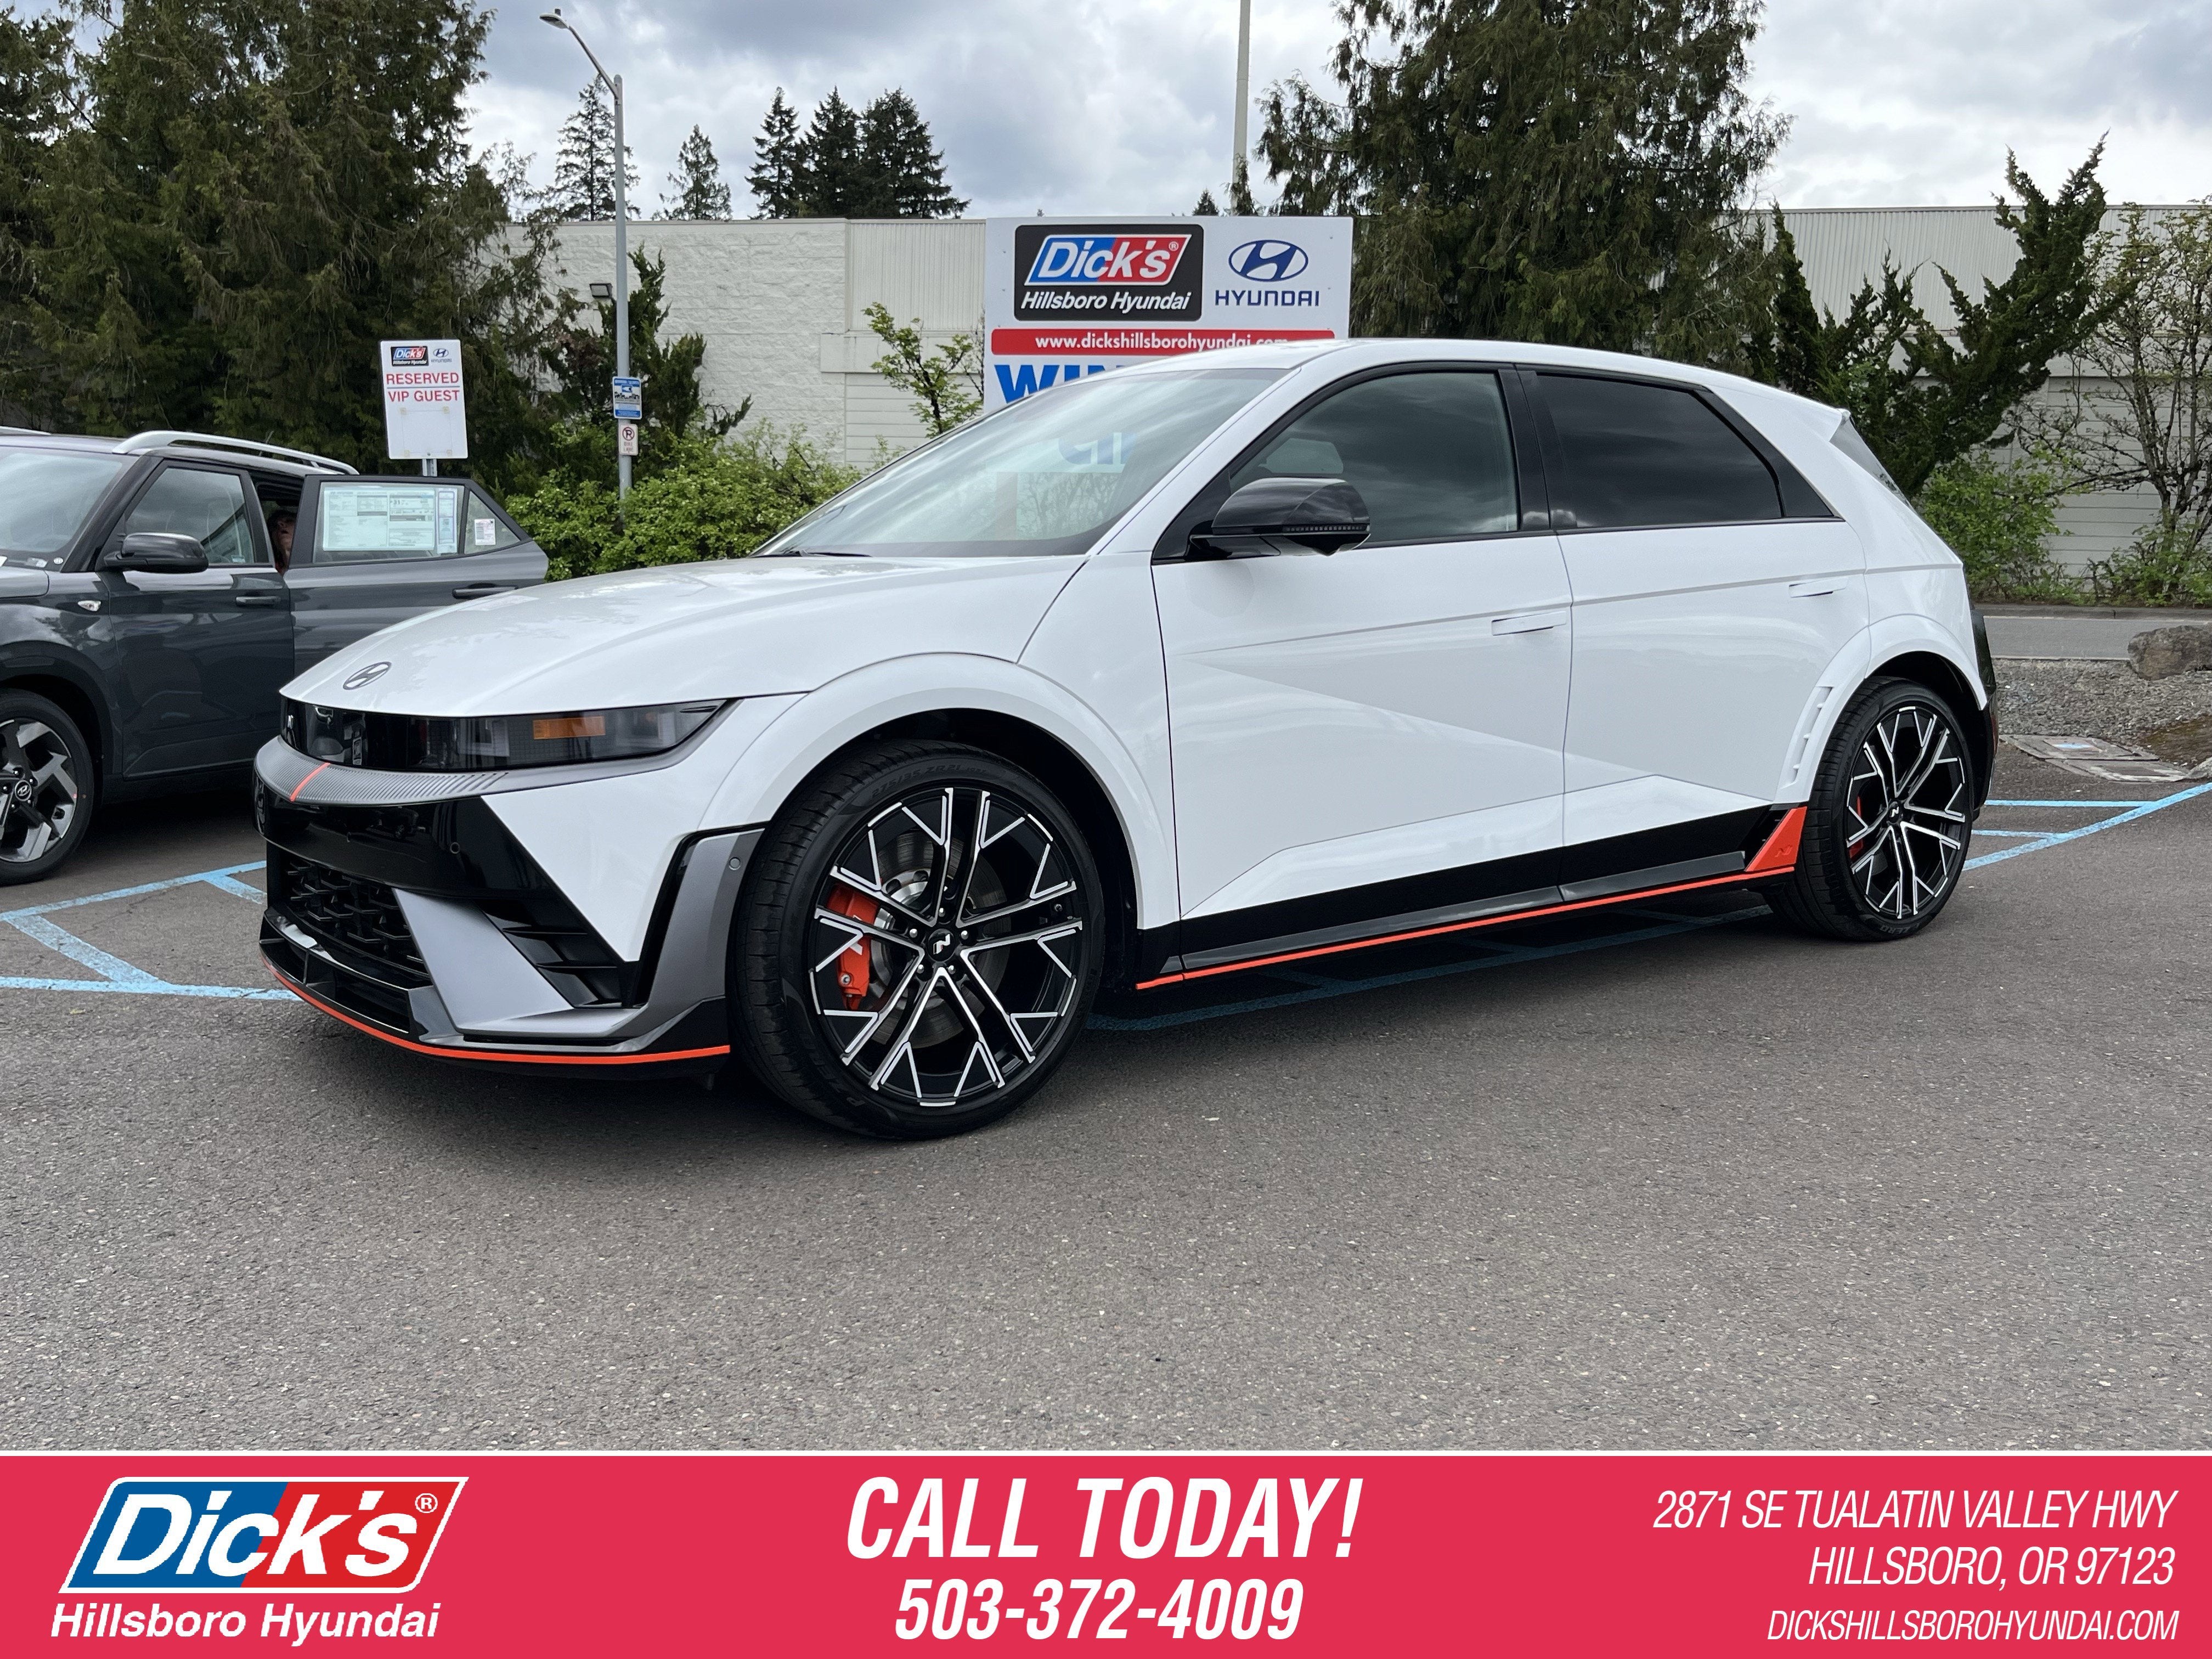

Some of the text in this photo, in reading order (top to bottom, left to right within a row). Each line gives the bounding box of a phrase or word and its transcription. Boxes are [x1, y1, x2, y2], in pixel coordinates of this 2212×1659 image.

[1020, 291, 1192, 314] Hillsboro Hyundai
[1215, 290, 1319, 307] HYUNDAI
[386, 372, 459, 385] RESERVED
[388, 390, 460, 402] VIP GUEST
